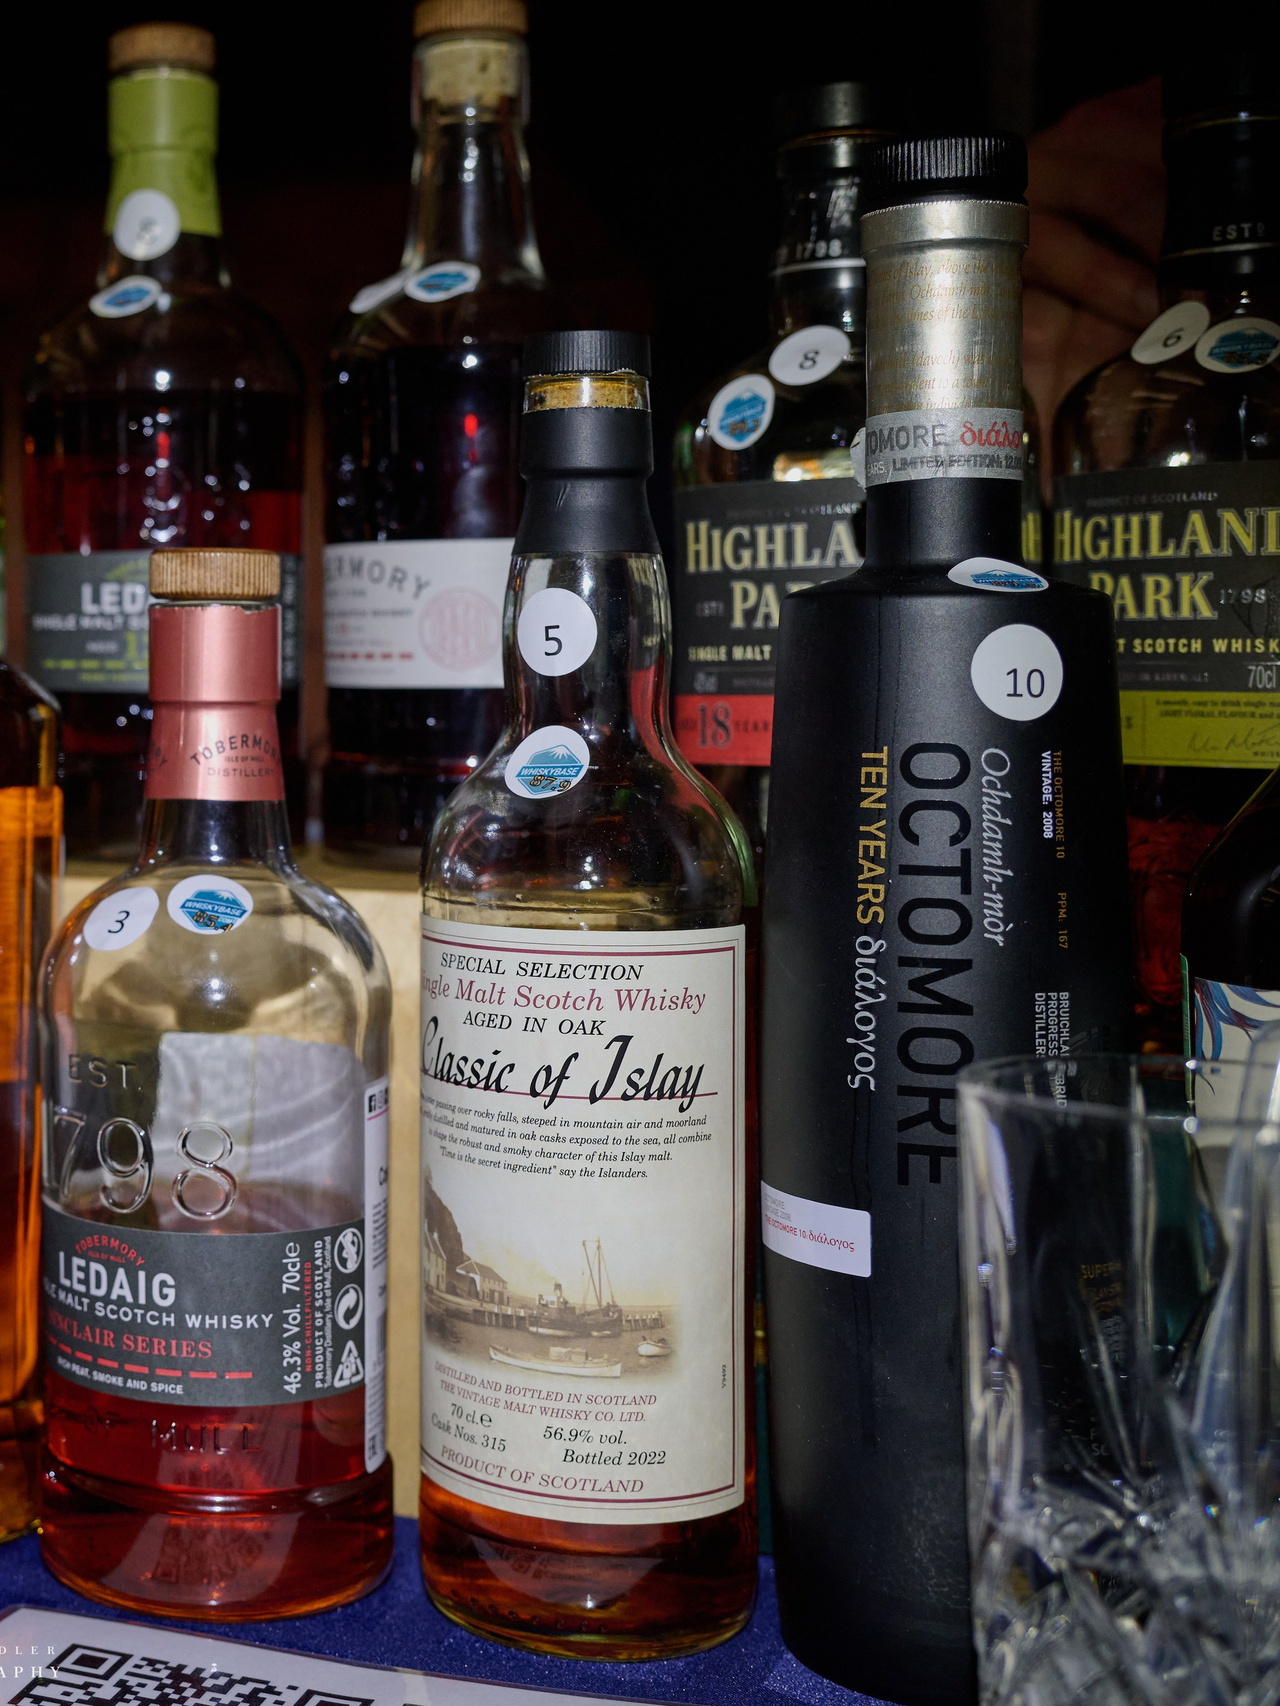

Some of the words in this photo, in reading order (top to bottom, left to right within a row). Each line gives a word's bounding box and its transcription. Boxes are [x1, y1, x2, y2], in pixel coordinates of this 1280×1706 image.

[1163, 327, 1185, 348] 6
[799, 348, 820, 371] 8
[685, 518, 866, 574] HIGHLA
[80, 582, 150, 615] LED
[730, 579, 805, 630] PA
[544, 624, 562, 656] 5
[732, 644, 773, 661] MALT
[1132, 637, 1203, 654] SCOTCH
[1006, 668, 1045, 698] 10
[1247, 665, 1277, 689] 70cl
[698, 702, 733, 749] 18
[519, 765, 581, 777] WHISKYBASE
[1052, 749, 1062, 773] THE
[530, 774, 572, 792] 87.9
[860, 745, 888, 809] TEN
[1040, 749, 1053, 806] VINTAGE:
[1053, 775, 1065, 842] OCTOMORE
[1042, 811, 1054, 840] 2008
[1055, 845, 1066, 860] 10
[855, 818, 887, 926] YEARS
[183, 899, 244, 917] WHISKYBASE
[1057, 890, 1068, 923] PPM:
[107, 910, 130, 934] 3
[1058, 929, 1069, 950] 167
[440, 952, 507, 975] SPECIAL
[516, 961, 645, 981] SELECTION
[896, 741, 975, 1187] OCTOMORE
[422, 970, 451, 1000] ingle
[455, 978, 507, 1006] Malt
[514, 985, 605, 1011] Scotch
[614, 987, 706, 1015] Whisky
[463, 1010, 513, 1030] AGED
[522, 1016, 548, 1033] IN
[558, 1018, 607, 1036] OAK
[845, 934, 887, 1093] διάλογος
[1058, 991, 1070, 1057] BRUICHLA
[421, 1016, 516, 1094] Classic
[529, 1051, 580, 1111] of
[588, 1035, 705, 1113] Islay
[457, 1106, 473, 1116] over
[473, 1109, 495, 1122] rocky
[496, 1110, 519, 1124] falls,
[521, 1116, 557, 1128] steeped
[559, 1117, 571, 1128] in
[573, 1119, 623, 1129] mountain
[626, 1118, 642, 1129] air
[644, 1117, 664, 1129] and
[665, 1114, 707, 1128] moorland
[448, 1133, 458, 1145] the
[459, 1135, 483, 1150] robust
[483, 1142, 501, 1153] and
[502, 1145, 533, 1159] smoky
[534, 1150, 583, 1161] character
[585, 1150, 598, 1163] of
[598, 1151, 618, 1162] this
[620, 1151, 646, 1164] Islay
[647, 1150, 673, 1162] malt.
[455, 1120, 469, 1131] and
[470, 1125, 505, 1138] matured
[507, 1128, 517, 1139] in
[519, 1130, 536, 1141] oak
[539, 1132, 567, 1144] casks
[569, 1134, 610, 1147] exposed
[612, 1136, 622, 1145] to
[624, 1135, 640, 1146] the
[642, 1137, 661, 1146] sea,
[663, 1133, 676, 1145] all
[678, 1131, 712, 1144] combine
[457, 1151, 464, 1162] is
[464, 1153, 476, 1165] the
[477, 1158, 501, 1169] secret
[503, 1159, 557, 1176] ingredient"
[559, 1167, 577, 1179] say
[579, 1167, 596, 1178] the
[598, 1167, 648, 1179] Islanders.
[74, 1234, 146, 1268] TOBERMORY
[808, 1229, 855, 1253] διάλογος
[58, 1250, 177, 1308] LEDAIG
[314, 1239, 324, 1311] SCOTLAND
[58, 1287, 91, 1313] MALT
[94, 1301, 176, 1328] SCOTCH
[184, 1313, 274, 1330] WHISKY
[282, 1303, 301, 1338] Vol.
[304, 1261, 313, 1373] NON-CHILLFILTERED
[314, 1312, 324, 1327] OF
[122, 1332, 213, 1359] SERIES
[314, 1329, 324, 1389] PRODUCT
[92, 1369, 125, 1387] SMOKE
[125, 1378, 149, 1391] AND
[150, 1381, 185, 1395] SPICE
[282, 1340, 302, 1395] 46.3%
[434, 1361, 477, 1386] DISTILLED
[478, 1379, 502, 1393] AND
[504, 1383, 564, 1403] BOTTLED
[567, 1393, 583, 1404] IN
[585, 1394, 658, 1406] SCOTLAND
[440, 1379, 455, 1395] THE
[457, 1387, 501, 1409] VINTAGE
[503, 1400, 537, 1415] MALT
[539, 1406, 592, 1421] WHISKY
[594, 1410, 616, 1422] CO.
[619, 1411, 646, 1422] LTD.
[450, 1402, 464, 1420] 70
[453, 1424, 478, 1445] Nos.
[481, 1434, 507, 1453] 315
[543, 1425, 594, 1444] 56.9%
[599, 1430, 628, 1445] vol.
[440, 1444, 507, 1479] PRODUCT
[510, 1468, 535, 1485] OF
[538, 1473, 645, 1494] SCOTLAND
[562, 1448, 623, 1466] Bottled
[627, 1450, 667, 1466] 2022
